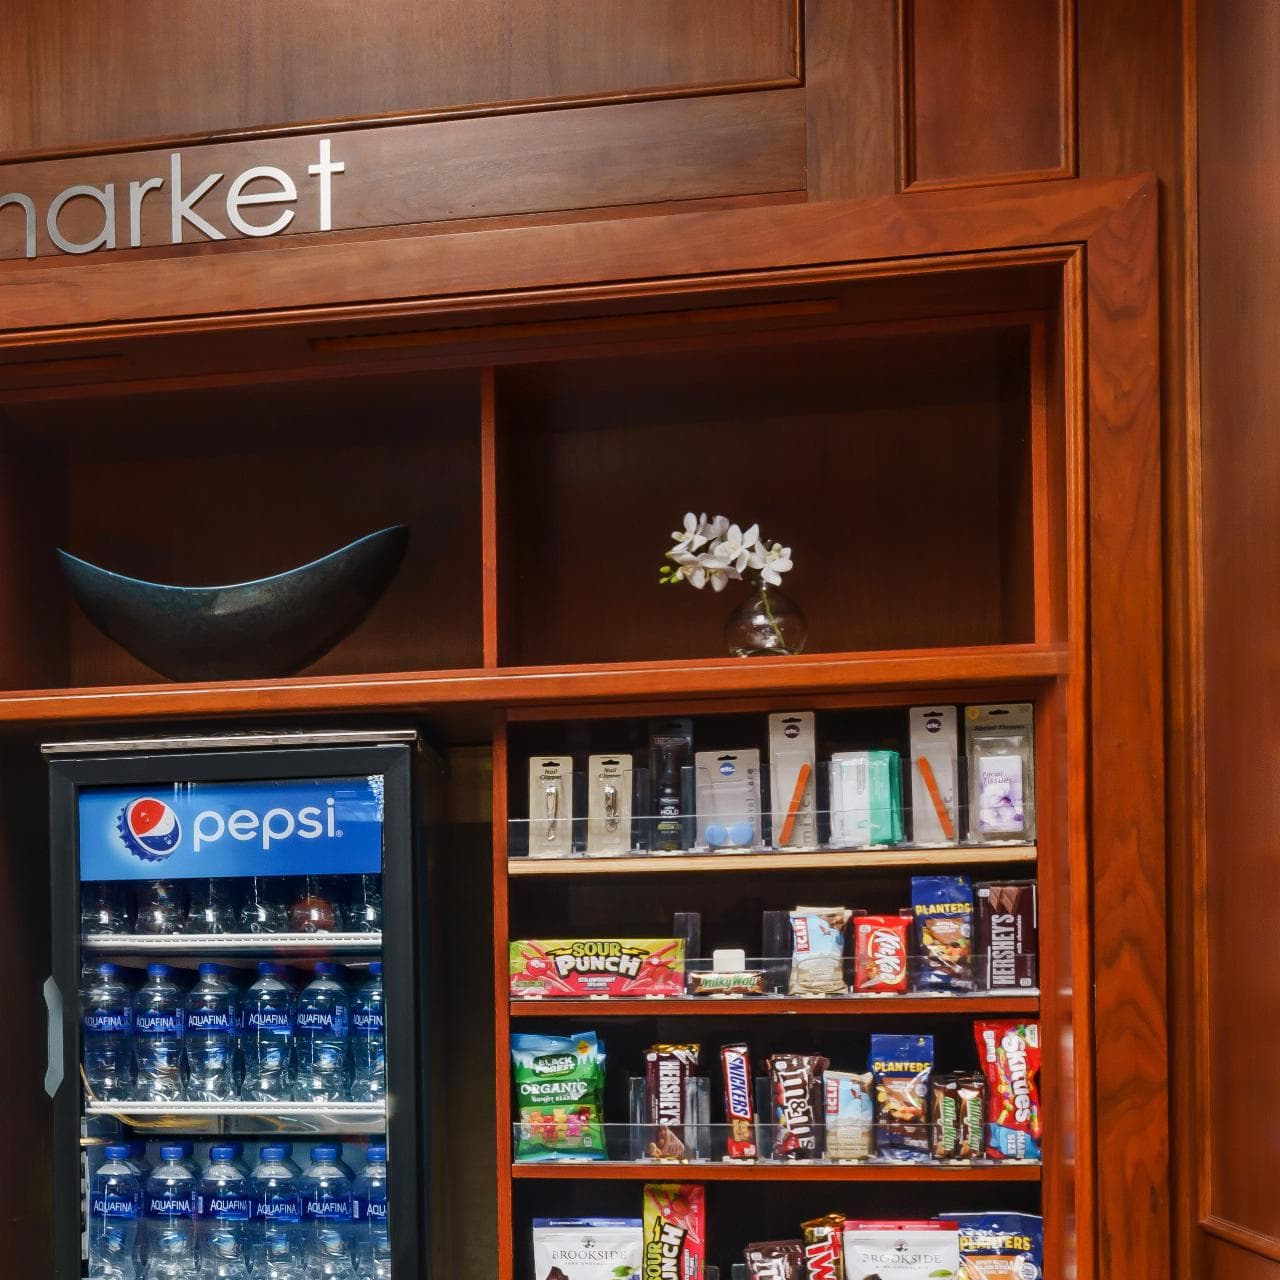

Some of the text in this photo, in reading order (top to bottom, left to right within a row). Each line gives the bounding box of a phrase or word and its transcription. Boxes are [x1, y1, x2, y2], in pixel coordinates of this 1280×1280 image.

[193, 797, 336, 852] pepsi
[915, 903, 971, 916] PLANTERS
[572, 942, 622, 957] SOUR
[991, 914, 1016, 985] HERSHEY'S
[555, 955, 642, 978] PUNCH
[188, 1015, 228, 1027] AQUAFINA
[248, 1013, 288, 1026] AQUAFINA
[539, 1057, 573, 1066] BLACK
[874, 1062, 930, 1073] PLANTERS
[536, 1064, 576, 1074] FOREST
[521, 1080, 589, 1096] ORGANIC
[727, 1056, 748, 1116] SNICKERS
[659, 1061, 681, 1126] HERSHEY'S
[94, 1200, 132, 1212] AQUAFINA
[151, 1200, 190, 1212] AQUAFINA
[257, 1203, 297, 1215] AQUAFINA
[307, 1201, 348, 1214] AQUAFINA
[552, 1250, 627, 1261] BROOKSIDE
[863, 1253, 943, 1264] BROOKSIDE
